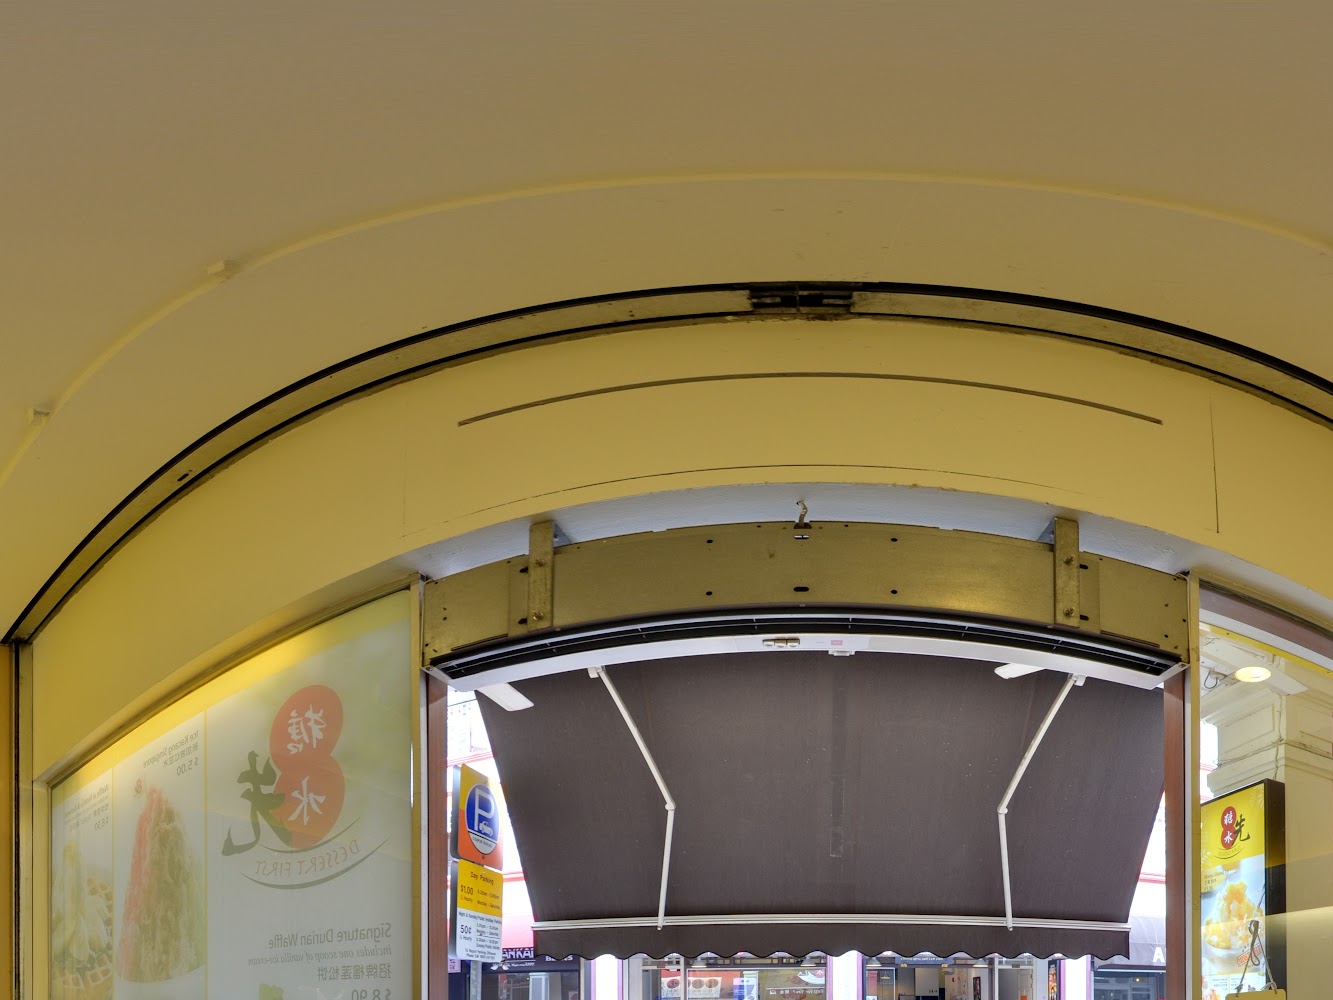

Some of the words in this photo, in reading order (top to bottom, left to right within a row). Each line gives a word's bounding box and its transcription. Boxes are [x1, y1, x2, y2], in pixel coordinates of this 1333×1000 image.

[473, 787, 495, 832] P
[470, 871, 478, 881] Day
[480, 874, 494, 886] Parking
[460, 884, 474, 896] $1.00
[460, 924, 472, 934] 50¢
